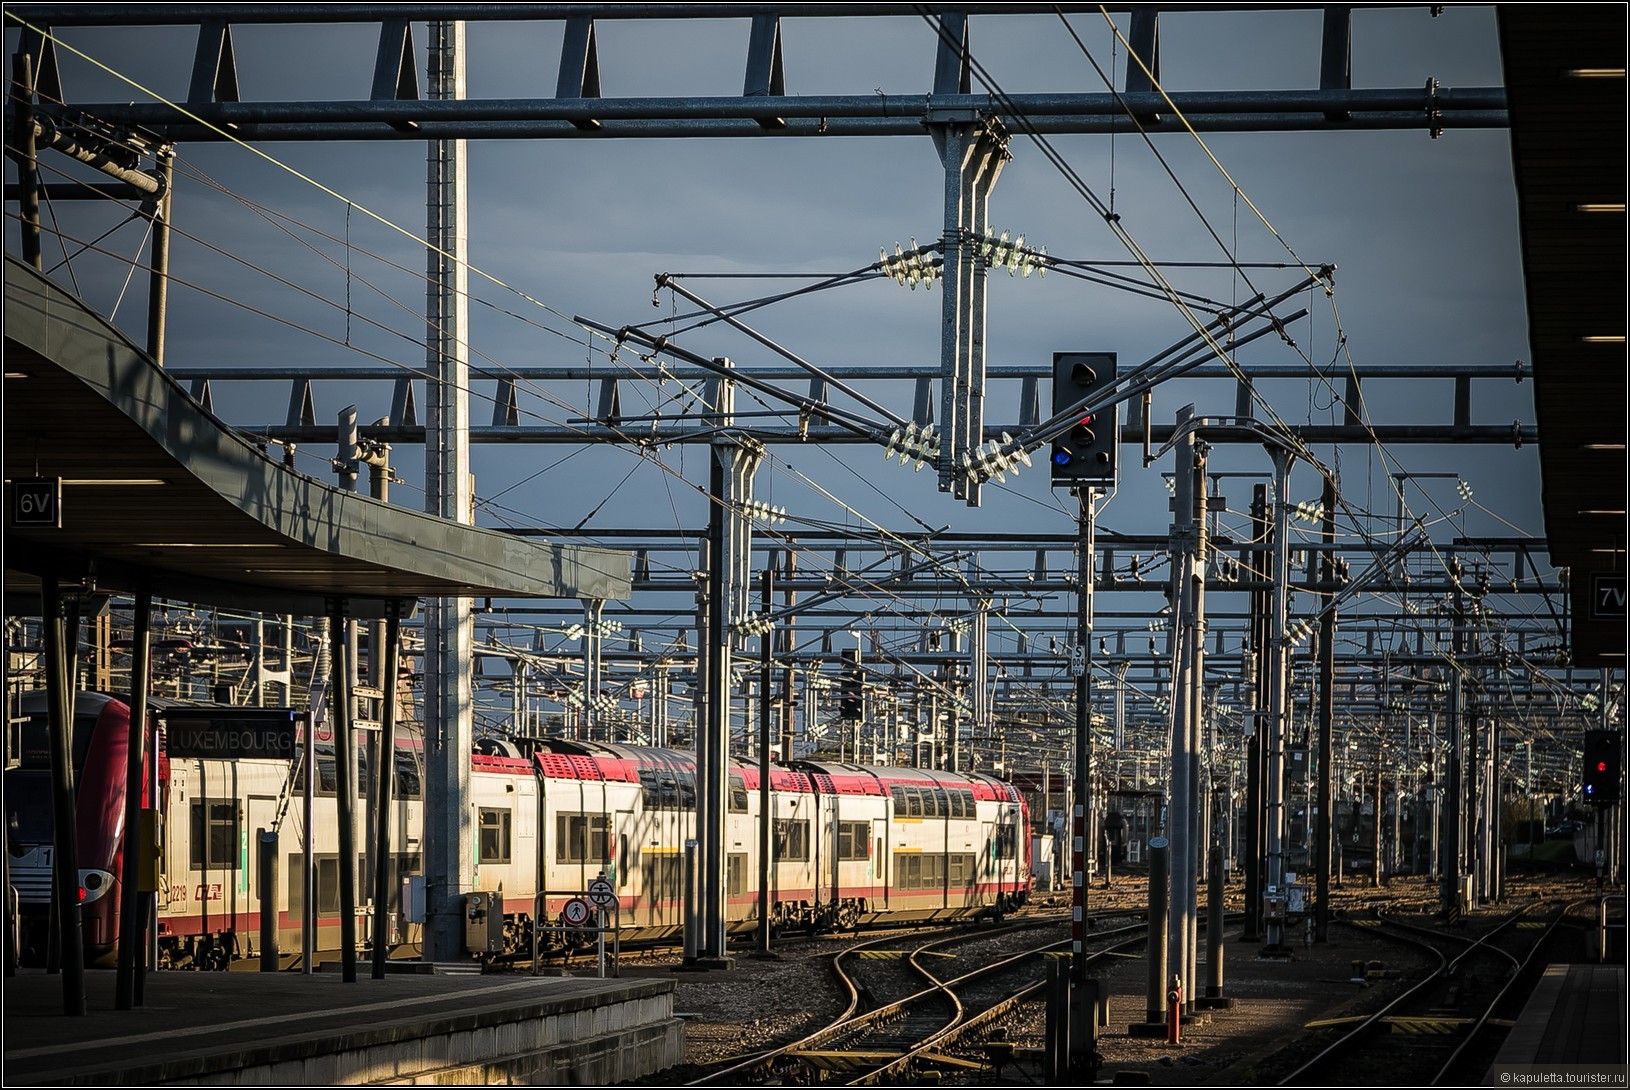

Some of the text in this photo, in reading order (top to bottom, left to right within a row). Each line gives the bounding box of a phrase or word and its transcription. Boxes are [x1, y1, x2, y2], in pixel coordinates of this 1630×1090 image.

[20, 493, 50, 513] 6V
[1599, 587, 1626, 607] 7V
[1075, 646, 1082, 658] S
[170, 730, 291, 750] LUXEMBOURG
[43, 849, 51, 865] 1
